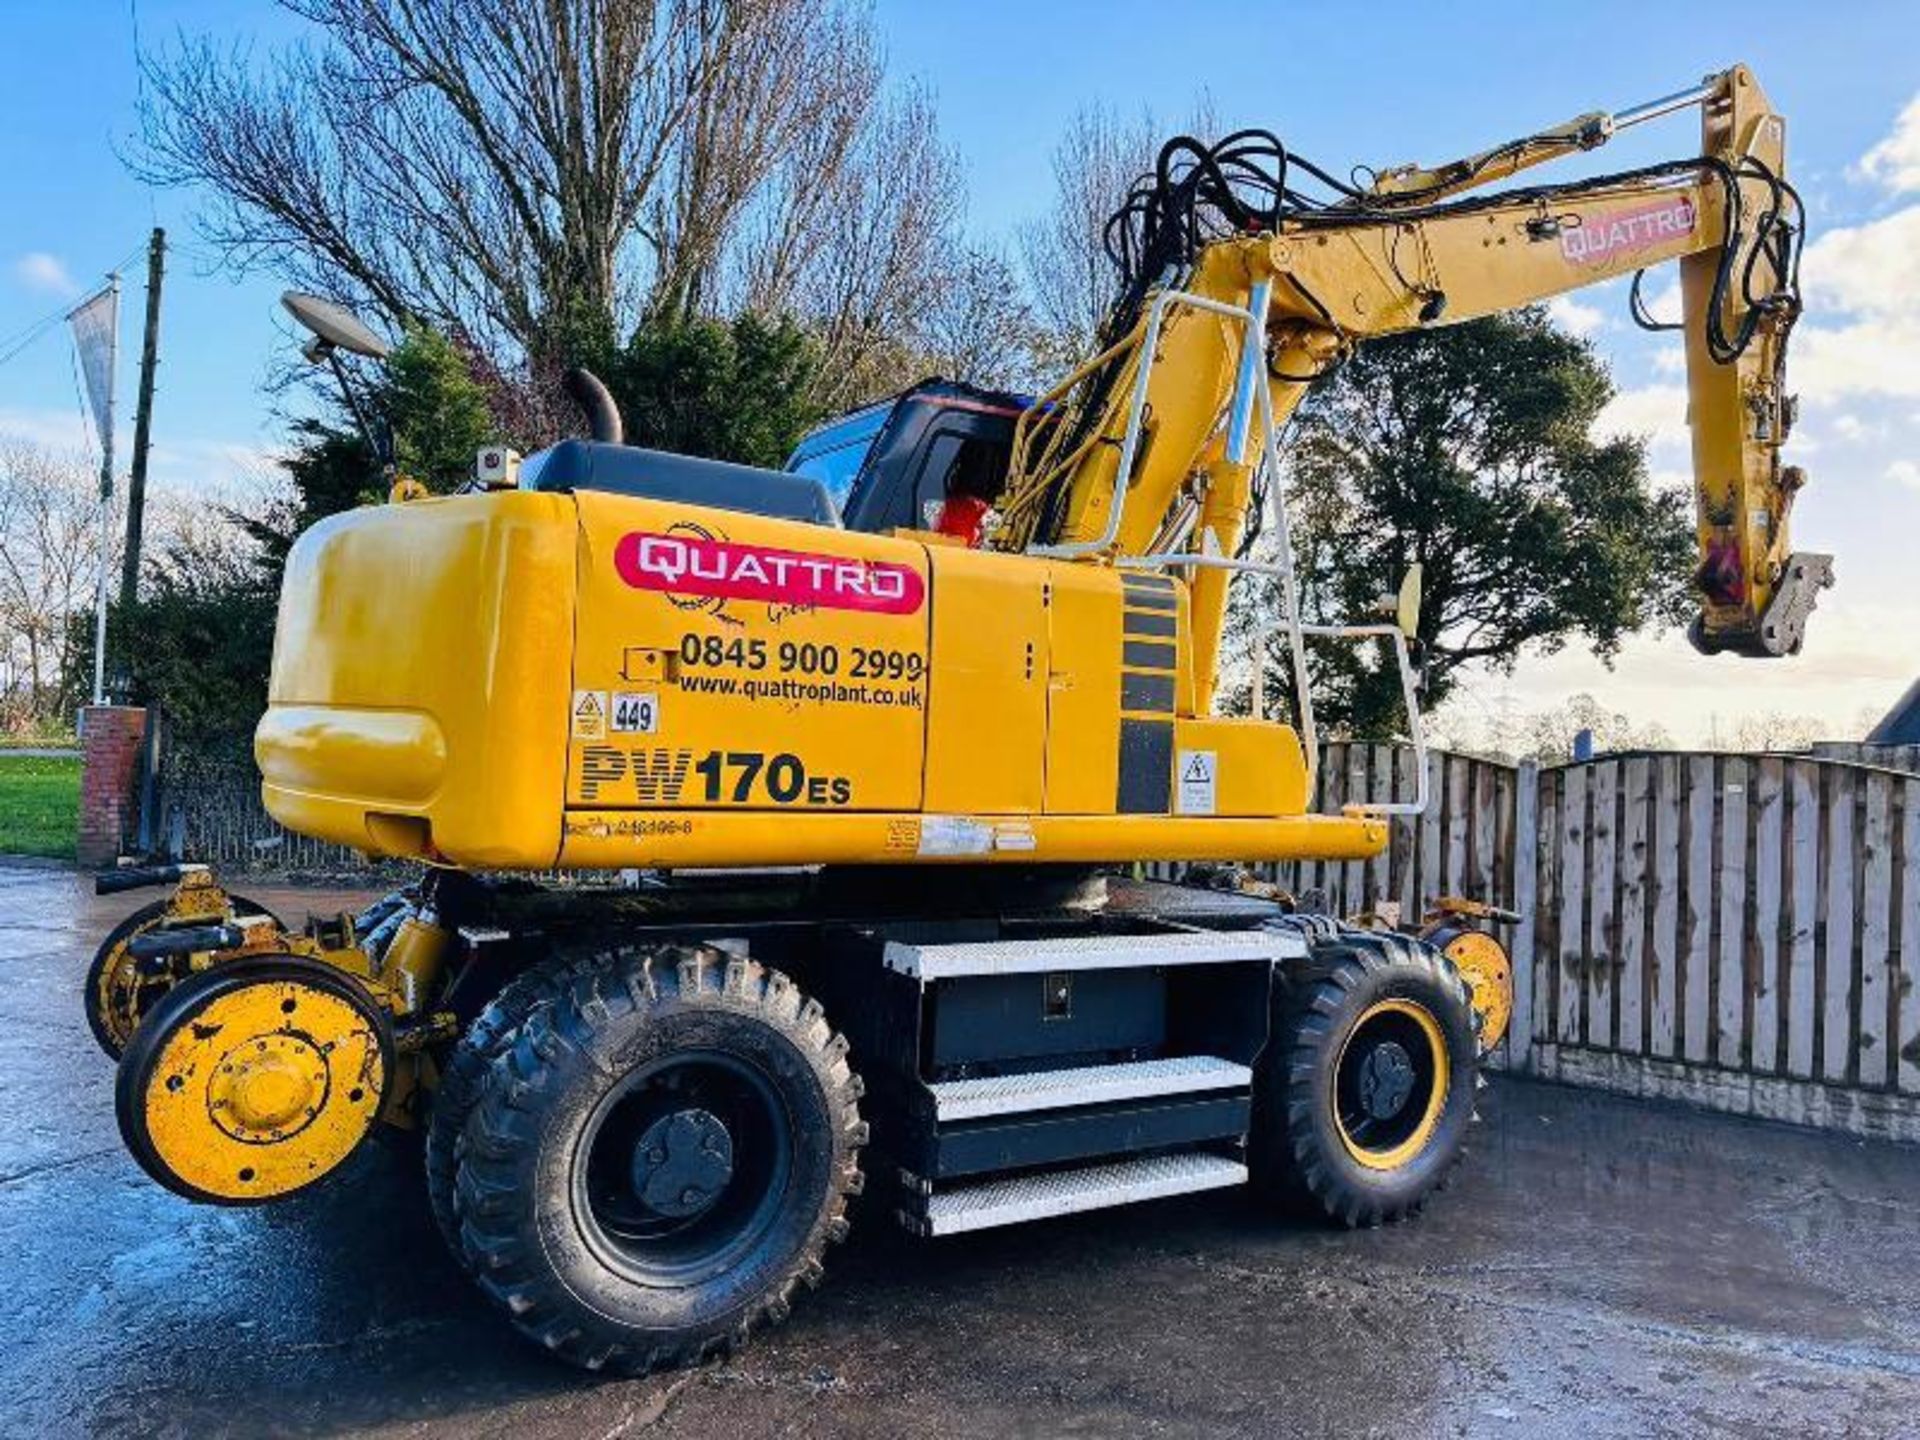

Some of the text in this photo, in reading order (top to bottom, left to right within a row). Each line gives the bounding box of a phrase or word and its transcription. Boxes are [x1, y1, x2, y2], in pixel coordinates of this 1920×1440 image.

[1562, 203, 1694, 263] QUATTRO
[638, 536, 906, 599] QUATTRO
[680, 632, 924, 681] 0845 900 2999
[616, 700, 651, 730] 449
[680, 675, 922, 709] www.quattroplant.co.uk
